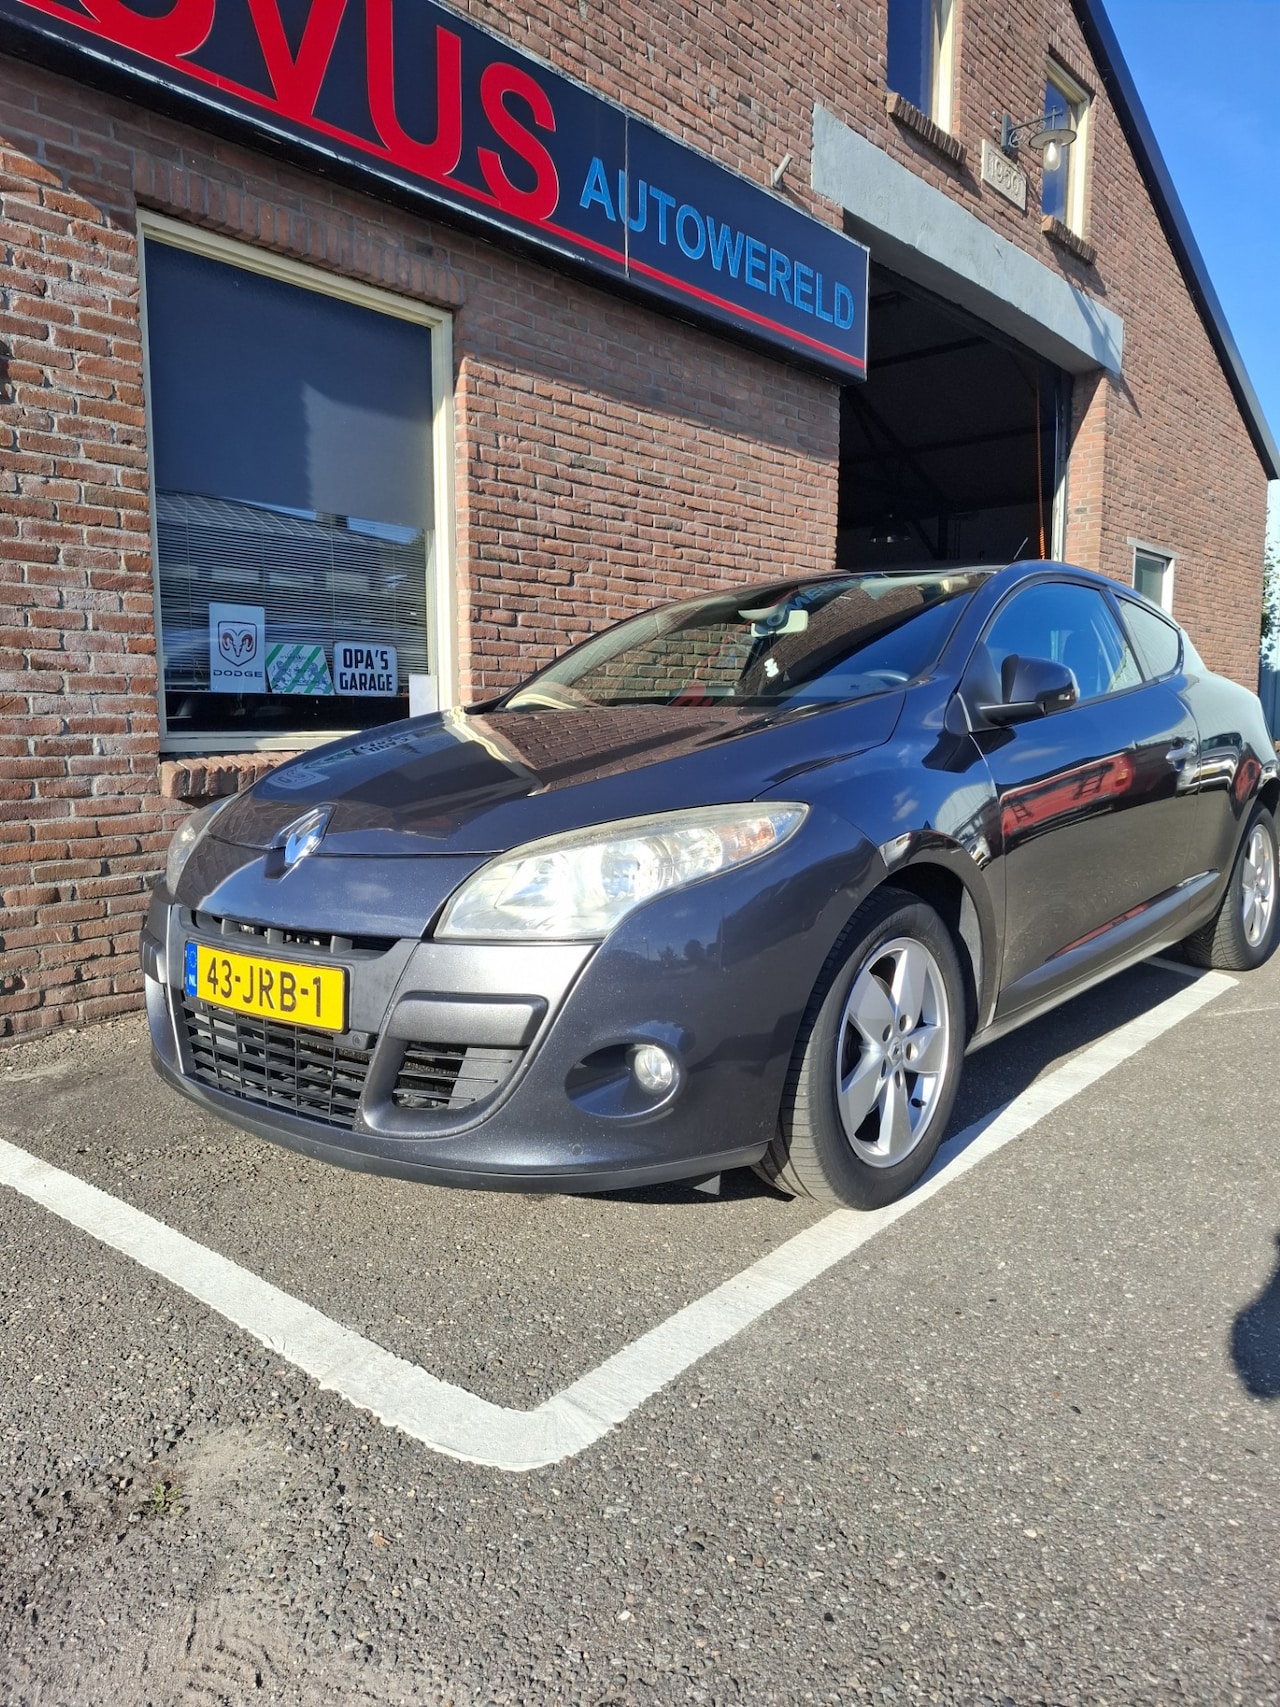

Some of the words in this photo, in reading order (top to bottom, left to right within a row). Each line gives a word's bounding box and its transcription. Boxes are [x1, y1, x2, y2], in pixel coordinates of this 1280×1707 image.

[579, 157, 855, 331] AUTOWERELD
[343, 648, 389, 670] OPA'S
[213, 669, 263, 678] DODGE
[340, 672, 393, 692] GARAGE
[188, 974, 198, 987] NL
[206, 956, 322, 1018] 43-JRB-1
